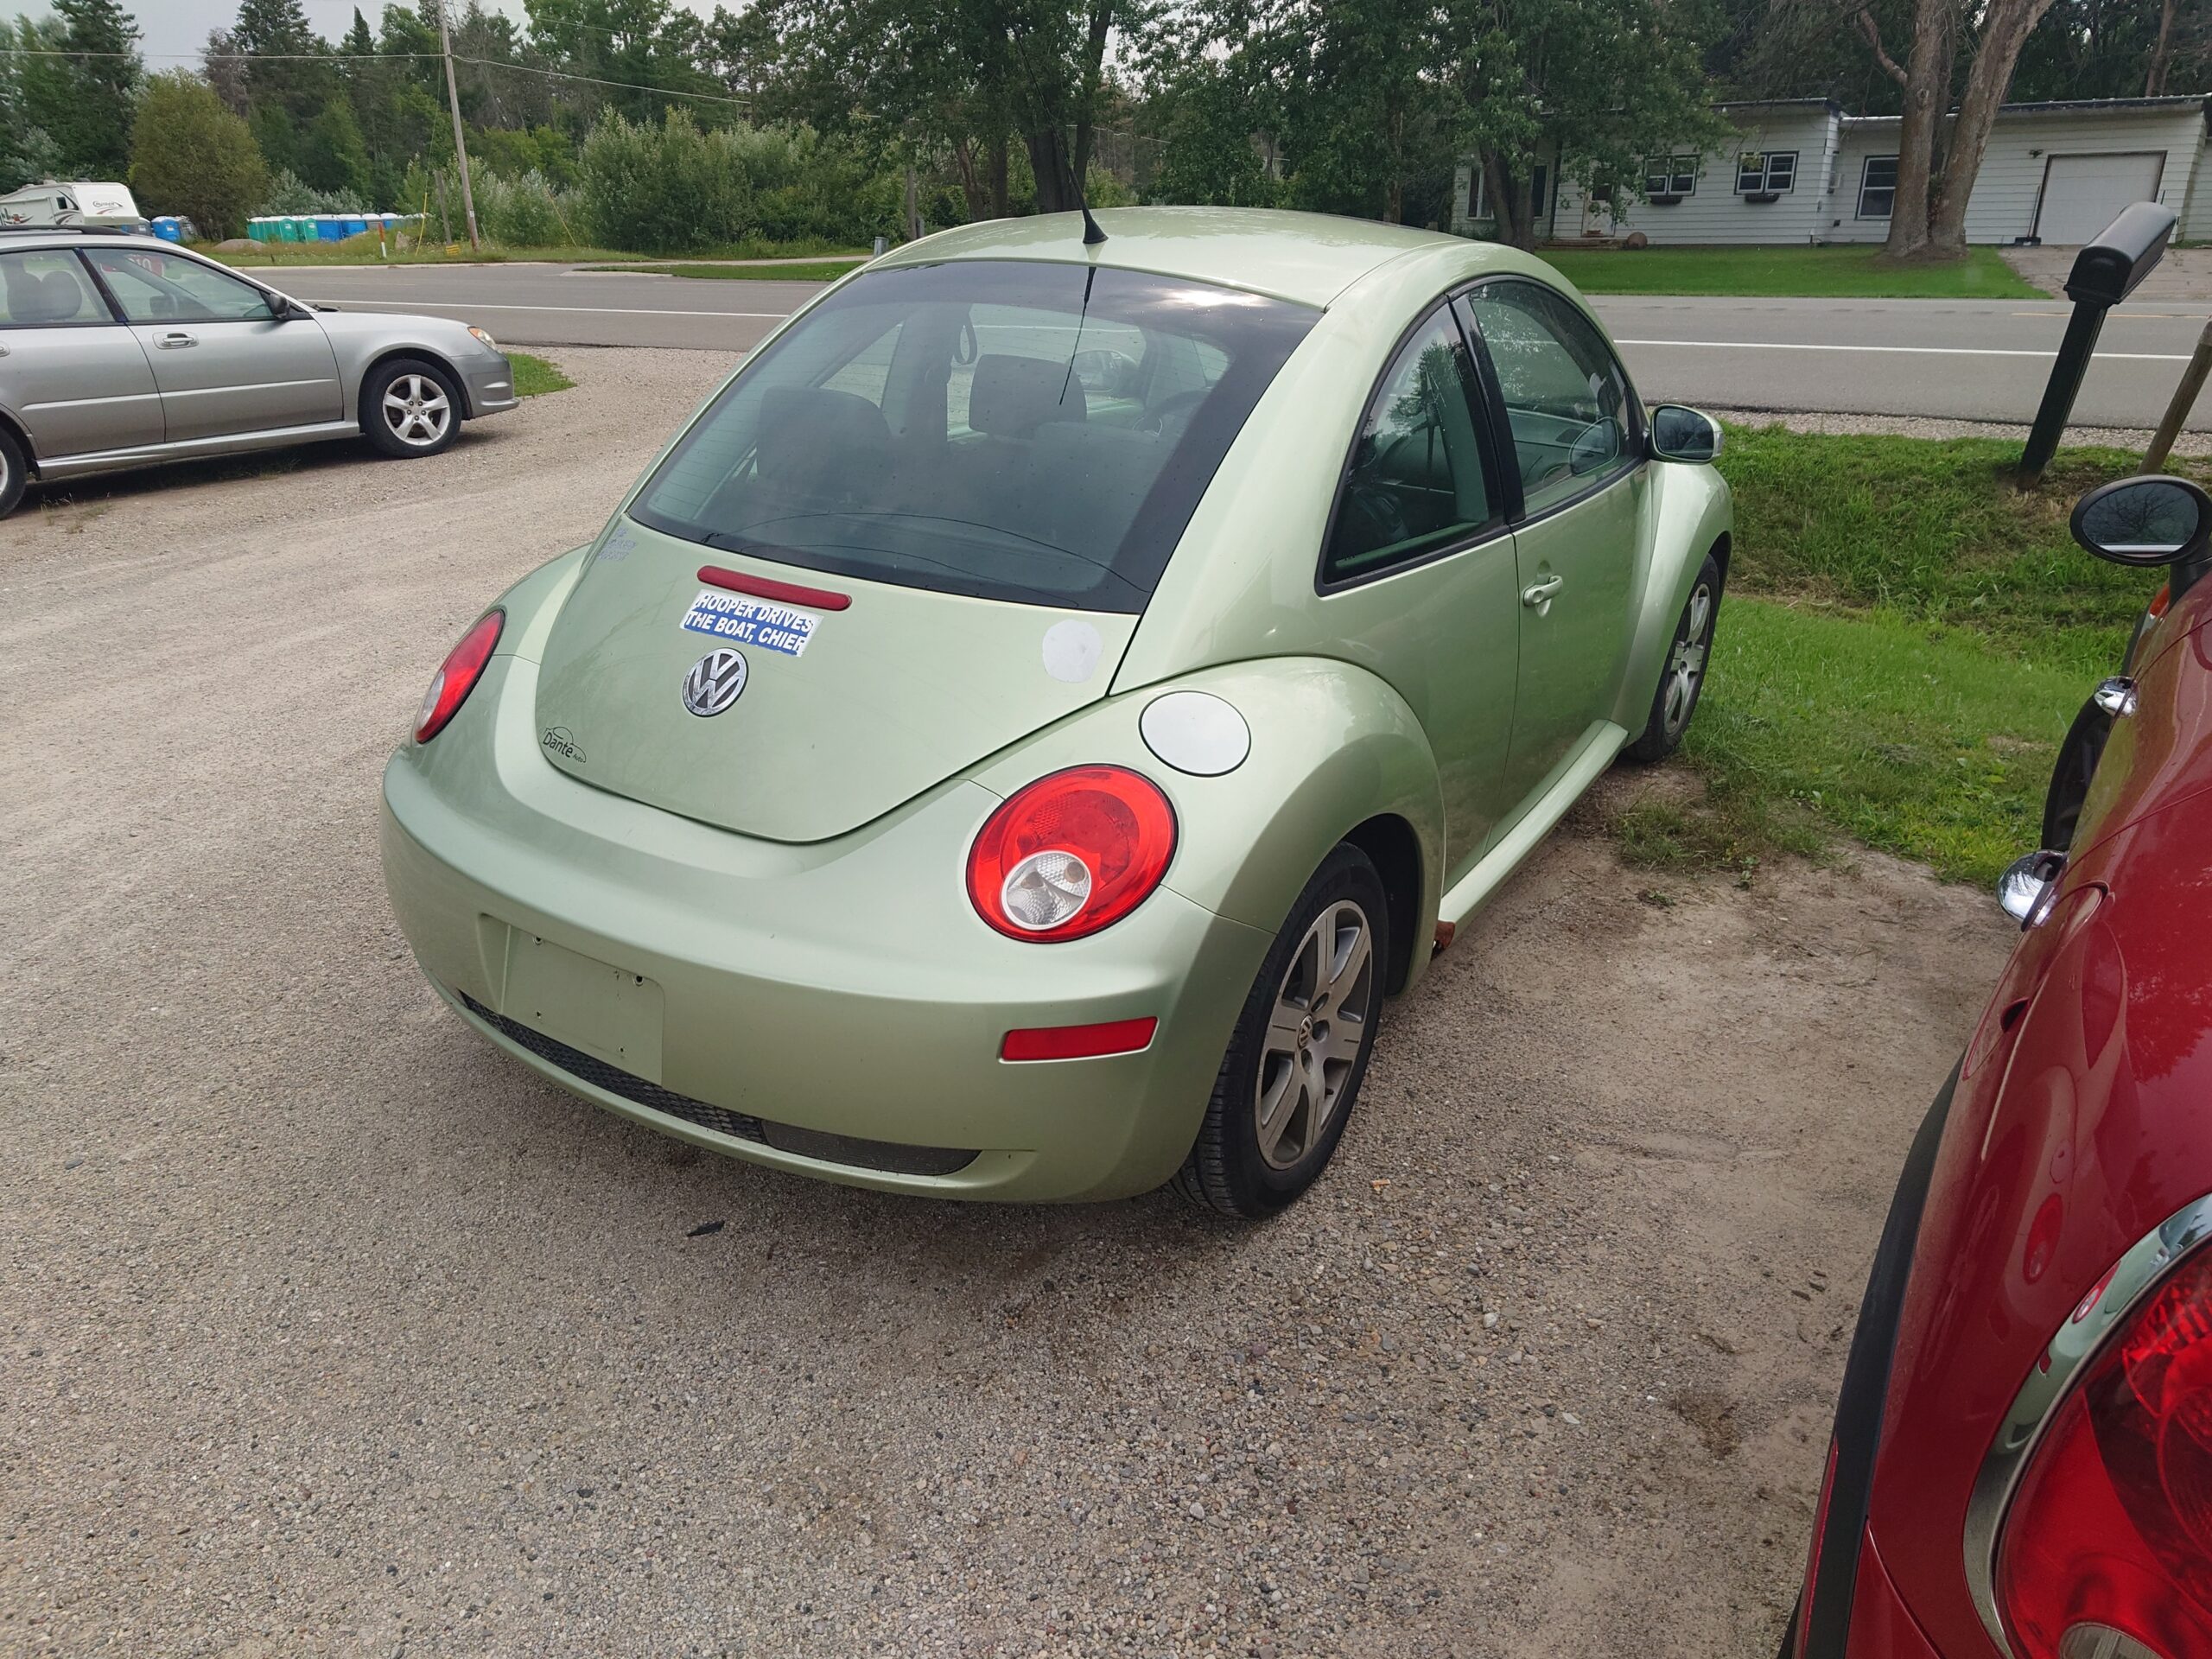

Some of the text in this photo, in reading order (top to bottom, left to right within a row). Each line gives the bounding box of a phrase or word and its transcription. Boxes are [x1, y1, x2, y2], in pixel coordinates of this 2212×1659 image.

[684, 612, 808, 652] THE BOAT, CHIEF
[695, 594, 814, 633] HOOPER DRIVES
[687, 650, 745, 713] VW
[543, 732, 574, 758] Dante
